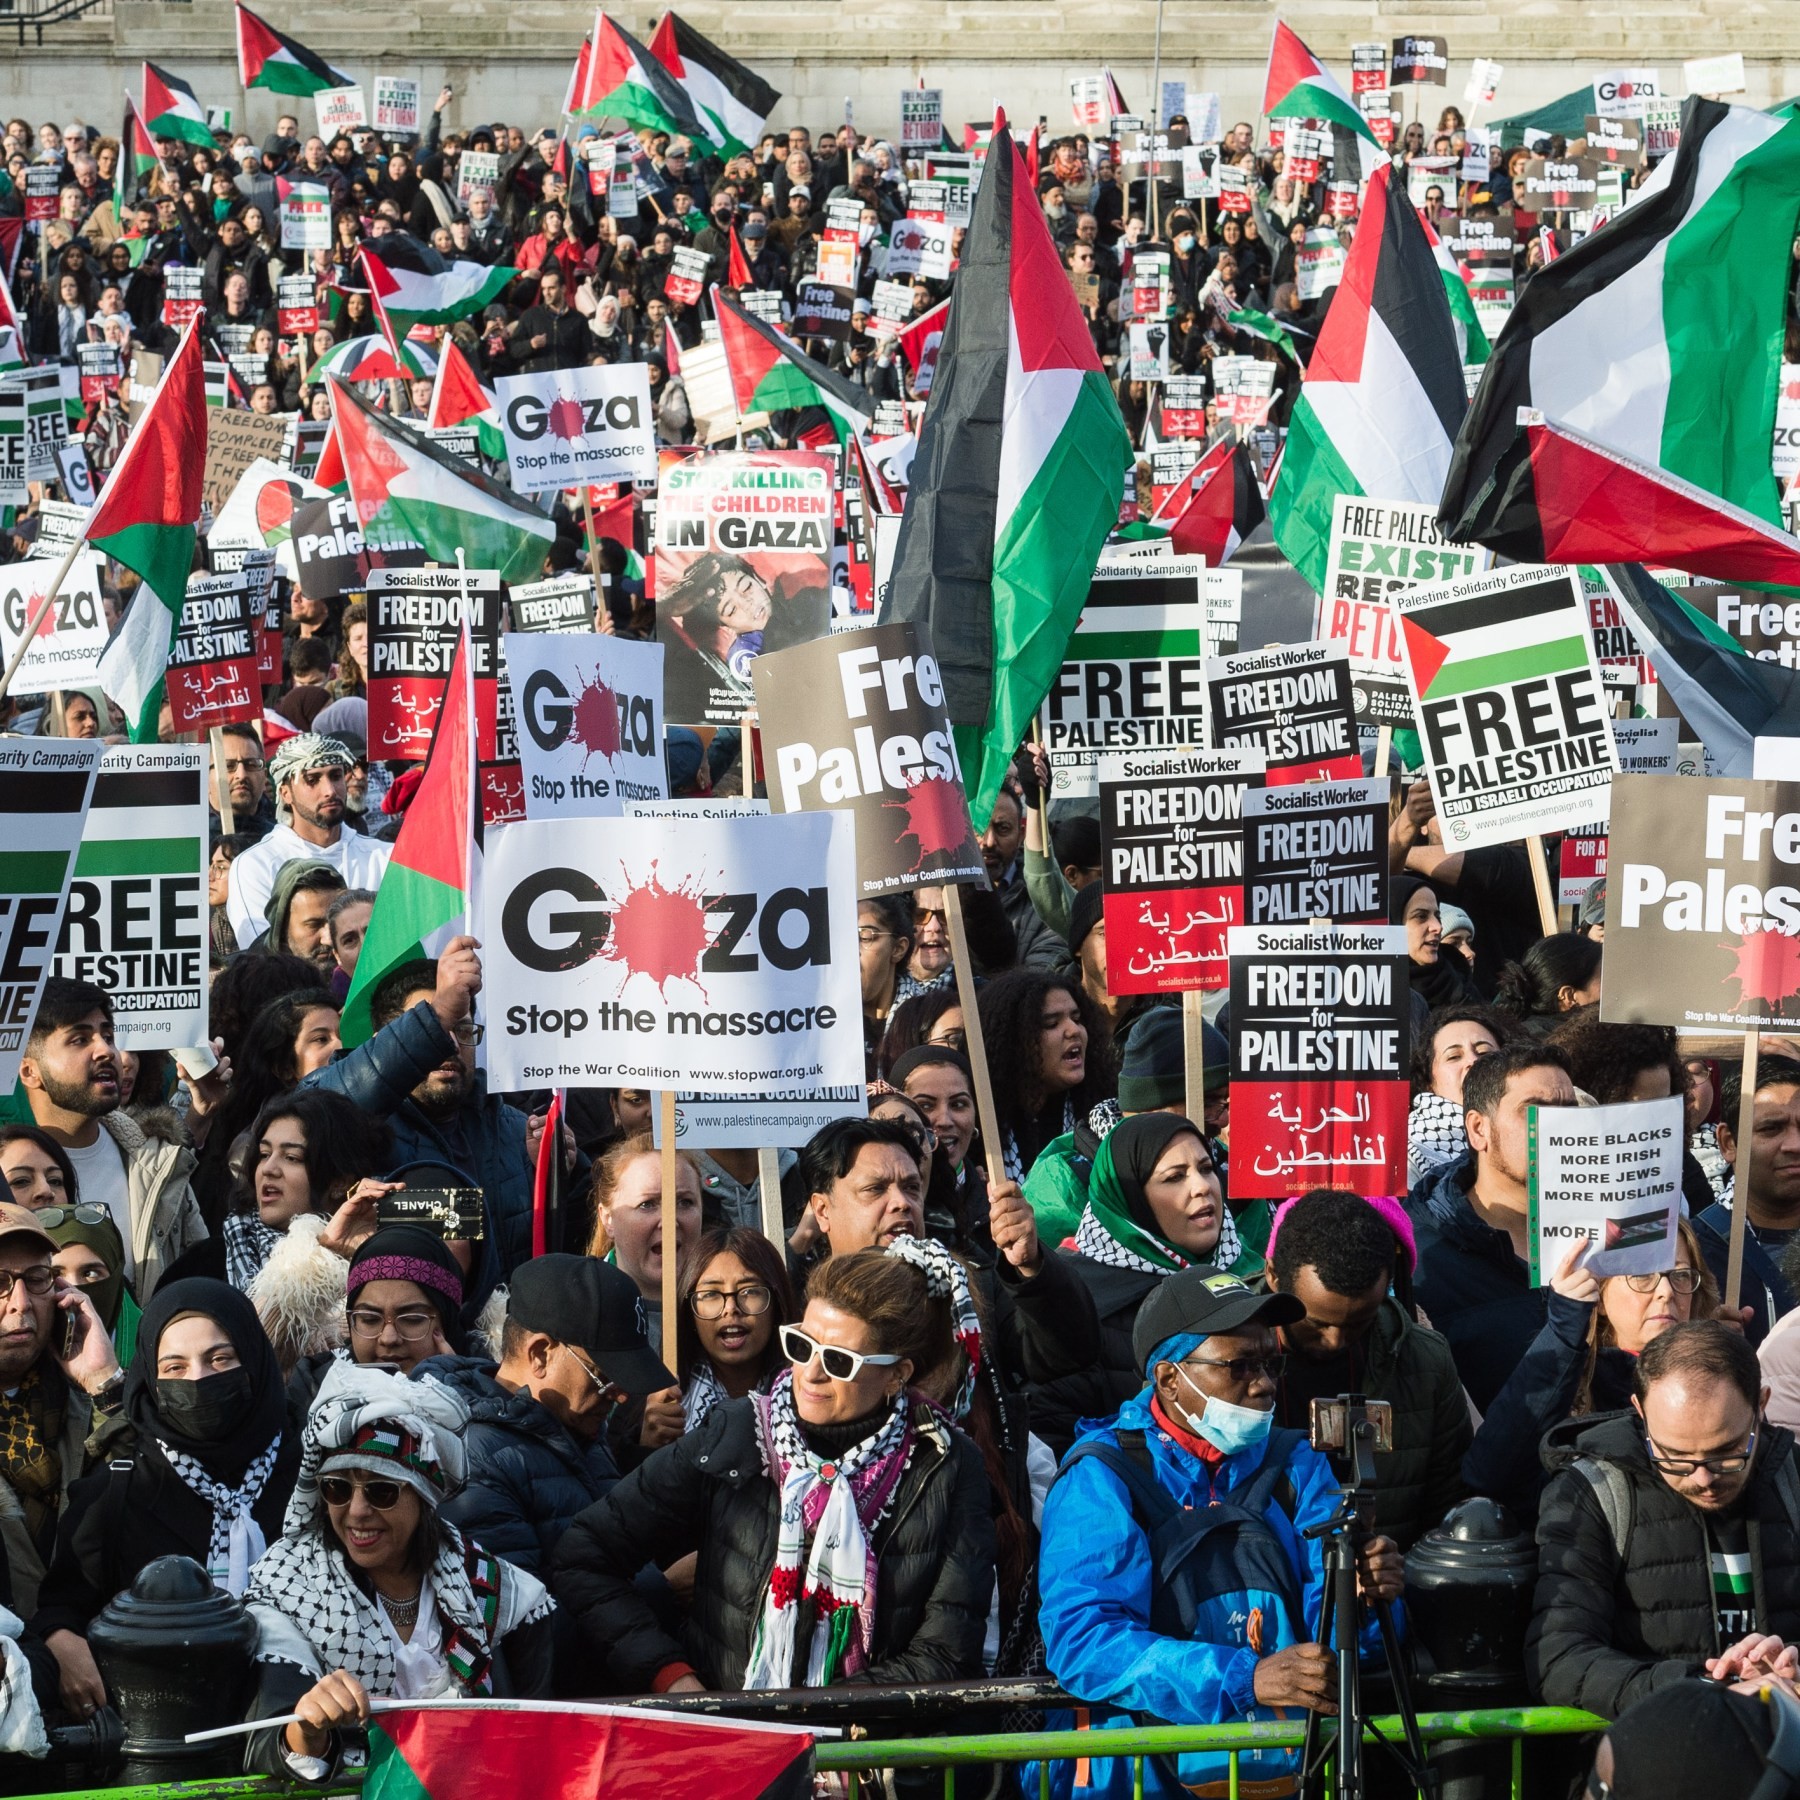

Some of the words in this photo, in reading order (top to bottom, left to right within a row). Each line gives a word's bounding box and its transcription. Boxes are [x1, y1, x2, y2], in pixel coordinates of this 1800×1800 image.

[1405, 38, 1435, 53] Free
[1544, 162, 1578, 177] Free
[1526, 177, 1596, 194] Palestine
[1459, 220, 1494, 235] Free
[1442, 235, 1512, 252] Palestine
[507, 395, 640, 441] Gza
[516, 453, 548, 470] Stop
[550, 450, 570, 466] the
[574, 443, 645, 463] massacre
[669, 470, 728, 489] STOP
[732, 471, 823, 490] KILLING
[664, 496, 704, 513] THE
[712, 496, 826, 513] CHILDREN
[667, 520, 705, 546] IN
[718, 517, 823, 549] GAZA
[1342, 505, 1386, 539] FREE
[1093, 564, 1143, 578] Solidarity
[1146, 563, 1198, 578] Campaign
[1338, 540, 1475, 581] EXIST!
[202, 580, 234, 594] Worker
[385, 573, 435, 588] Socialist
[436, 576, 479, 588] Worer
[522, 586, 549, 597] Socialist
[551, 582, 577, 593] Worker
[1397, 588, 1450, 609] Palestine
[1452, 574, 1507, 598] Solidarity
[1510, 563, 1569, 585] Campaign
[520, 595, 586, 625] FREEDOM
[198, 624, 212, 637] for
[420, 627, 441, 642] for
[28, 651, 46, 666] the
[1226, 655, 1281, 674] Socialist
[1282, 649, 1326, 668] Worker
[183, 666, 239, 693] الحرية
[838, 646, 946, 719] Fre
[1049, 660, 1203, 720] FREE
[183, 688, 251, 720] لفلسطين
[1222, 669, 1337, 718] FREEDOM
[523, 669, 656, 757] Gza
[1275, 711, 1294, 726] for
[1421, 668, 1604, 766] FREE
[1049, 718, 1203, 749] PALESTINE
[32, 750, 94, 769] Campaign
[137, 754, 201, 770] Campaign
[1052, 751, 1077, 766] END
[1123, 759, 1187, 778] Socialist
[1188, 757, 1241, 775] Worker
[1435, 734, 1611, 797] PALESTINE
[532, 775, 565, 803] Stop
[571, 775, 610, 798] the
[1265, 792, 1324, 811] Socialist
[1325, 787, 1368, 806] Worker
[1444, 801, 1473, 817] END
[1476, 788, 1528, 811] ISRAELI
[1530, 767, 1612, 799] OCCUPATION
[1116, 783, 1247, 827] FREEDOM
[1475, 798, 1593, 831] www.palestinecampaign.org
[1173, 824, 1196, 842] for
[1257, 814, 1374, 862] FREEDOM
[1706, 795, 1800, 864] Fre
[1576, 841, 1596, 857] FOR
[1598, 841, 1605, 855] A
[1112, 841, 1243, 885] PALESTIN
[1309, 859, 1329, 879] for
[863, 878, 884, 892] Stop
[885, 876, 899, 888] the
[901, 872, 918, 884] War
[919, 867, 956, 882] Coalition
[1252, 873, 1380, 924] PALESTINE
[54, 877, 201, 953] REE
[501, 867, 832, 973] Gza
[1138, 896, 1234, 935] الحرية
[1257, 934, 1328, 951] Socialist
[1330, 933, 1385, 951] Worker
[1157, 975, 1222, 988] socialistworker.co.uk
[1248, 965, 1391, 1006] FREEDOM
[506, 1004, 588, 1038] Stop
[598, 1002, 656, 1033] the
[667, 1004, 837, 1036] massacre
[1311, 1007, 1333, 1028] for
[1685, 1010, 1704, 1023] Stop
[1705, 1011, 1718, 1022] the
[1719, 1012, 1734, 1023] War
[1735, 1014, 1771, 1026] Coalition
[1240, 1030, 1399, 1072] PALESTINE
[523, 1065, 554, 1079] Stop
[558, 1064, 581, 1076] the
[584, 1064, 612, 1076] War
[617, 1064, 680, 1079] Coalition
[689, 1063, 824, 1082] www.stopwar.org.uk
[696, 1113, 832, 1128] www.palestinecampaign.org
[1268, 1092, 1370, 1133] الحرية
[1549, 1136, 1599, 1147] MORE
[1604, 1128, 1672, 1146] BLACKS
[1253, 1133, 1386, 1177] لفلسطين
[1560, 1154, 1610, 1165] MORE
[1616, 1148, 1661, 1164] IRISH
[1560, 1173, 1610, 1184] MORE
[1616, 1166, 1661, 1183] JEWS
[1544, 1190, 1594, 1202] MORE
[1600, 1181, 1675, 1202] MUSLIMS
[394, 1200, 442, 1211] CHANEL
[1543, 1225, 1599, 1241] MORE
